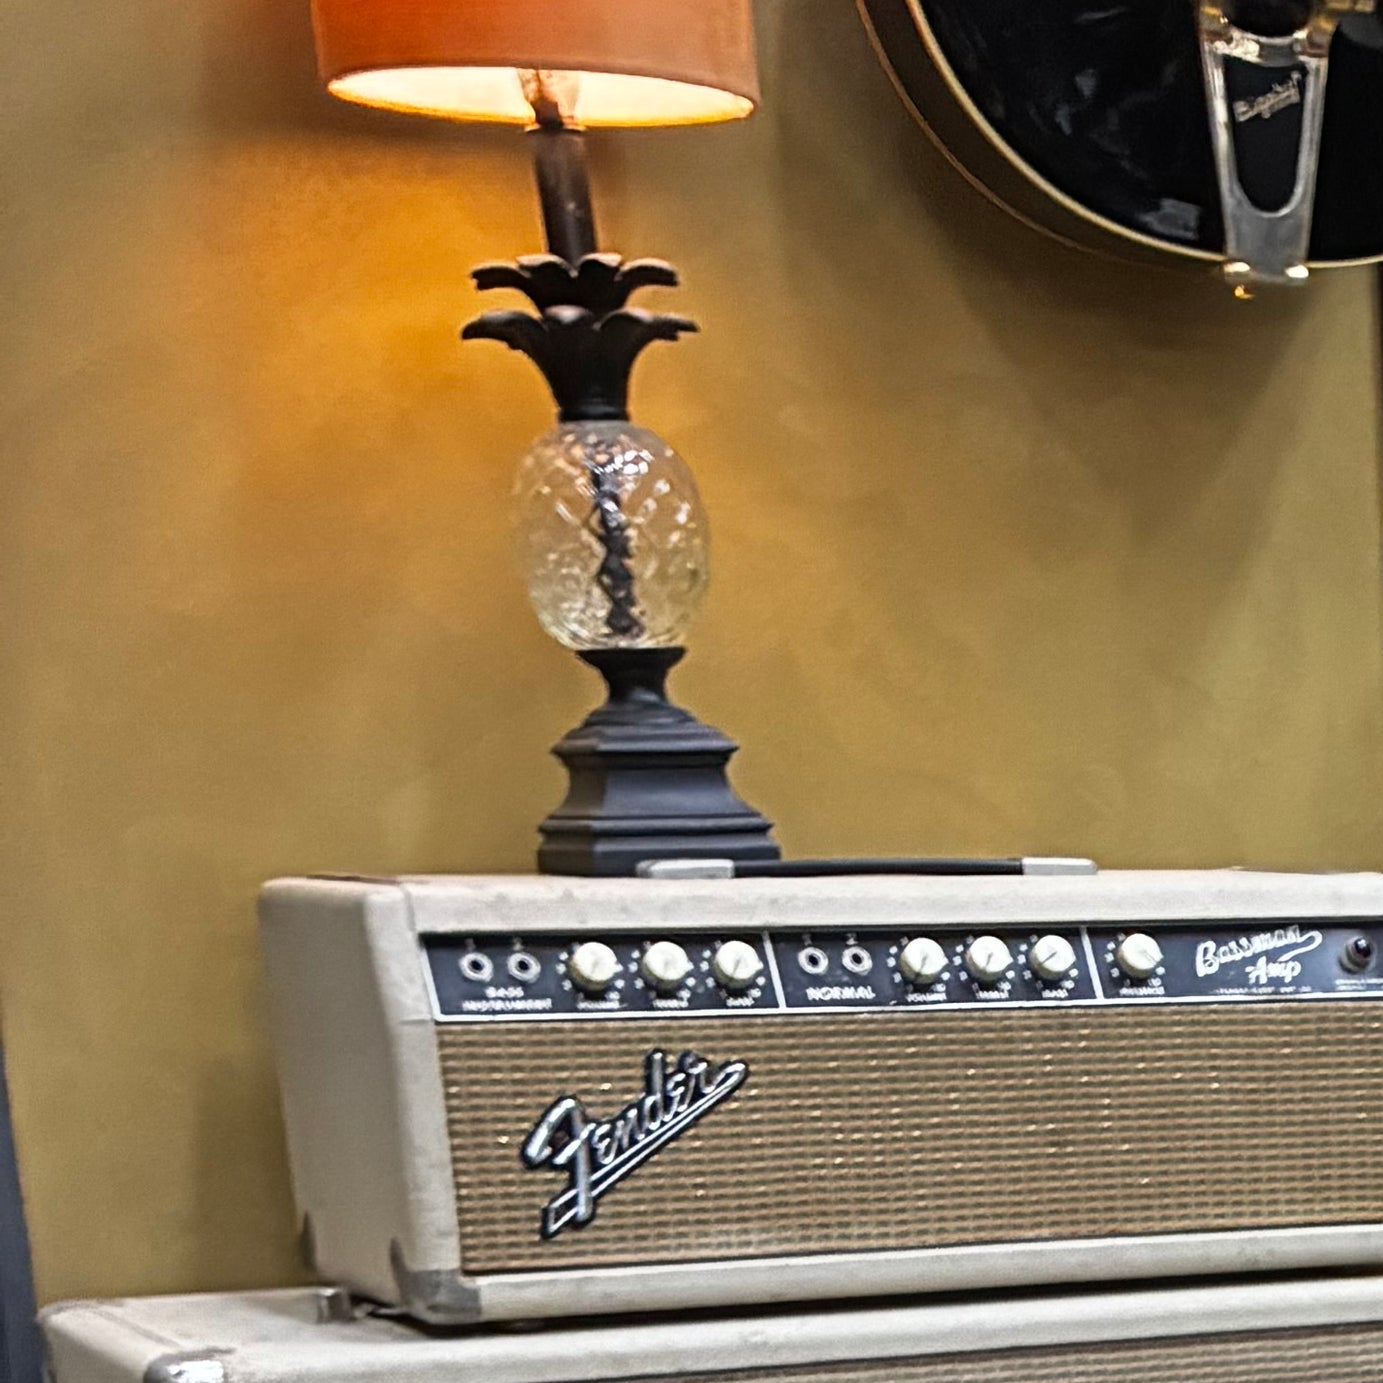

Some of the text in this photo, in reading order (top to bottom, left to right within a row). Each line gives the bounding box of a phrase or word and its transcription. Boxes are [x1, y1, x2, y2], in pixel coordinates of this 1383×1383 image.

[1196, 925, 1322, 977] Bassman
[1245, 956, 1301, 984] Amp
[806, 986, 876, 1001] NORMAL
[521, 1047, 750, 1239] Fender
